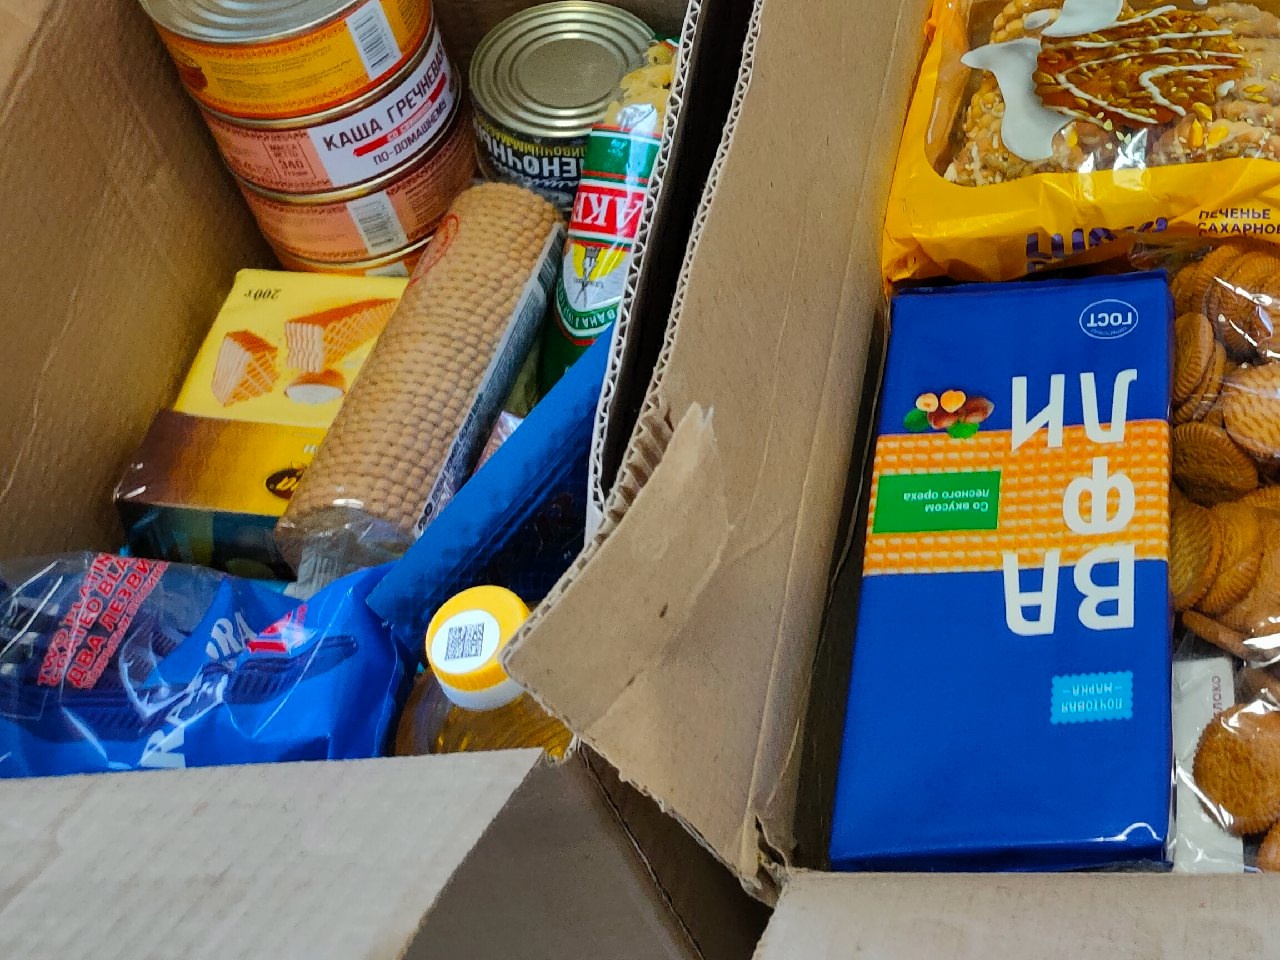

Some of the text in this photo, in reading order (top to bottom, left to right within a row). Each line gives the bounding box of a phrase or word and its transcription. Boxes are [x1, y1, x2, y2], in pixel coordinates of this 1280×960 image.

[385, 40, 448, 133] ГРЕЧНЕВАЯ
[322, 112, 383, 152] КАША
[373, 100, 448, 167] ПО-ДОМАШНЕМУ
[471, 119, 585, 179] ЕНОЧНЫ
[1199, 208, 1271, 220] ПЕЧЕНЬЕ
[243, 288, 282, 300] 200г
[1086, 312, 1133, 328] ГОСТ
[1011, 368, 1138, 453] ЛИ
[903, 489, 990, 502] лесного ореха
[925, 500, 989, 513] Со вкусом
[63, 553, 116, 628] PLATIN
[97, 556, 128, 598] BLA
[1002, 543, 1136, 636] ВА
[66, 634, 108, 690] ДВА
[99, 558, 153, 632] ЛЕЗВИ
[1061, 697, 1123, 714] ПОЧТОВАЯ
[1072, 682, 1113, 697] МАРКА
